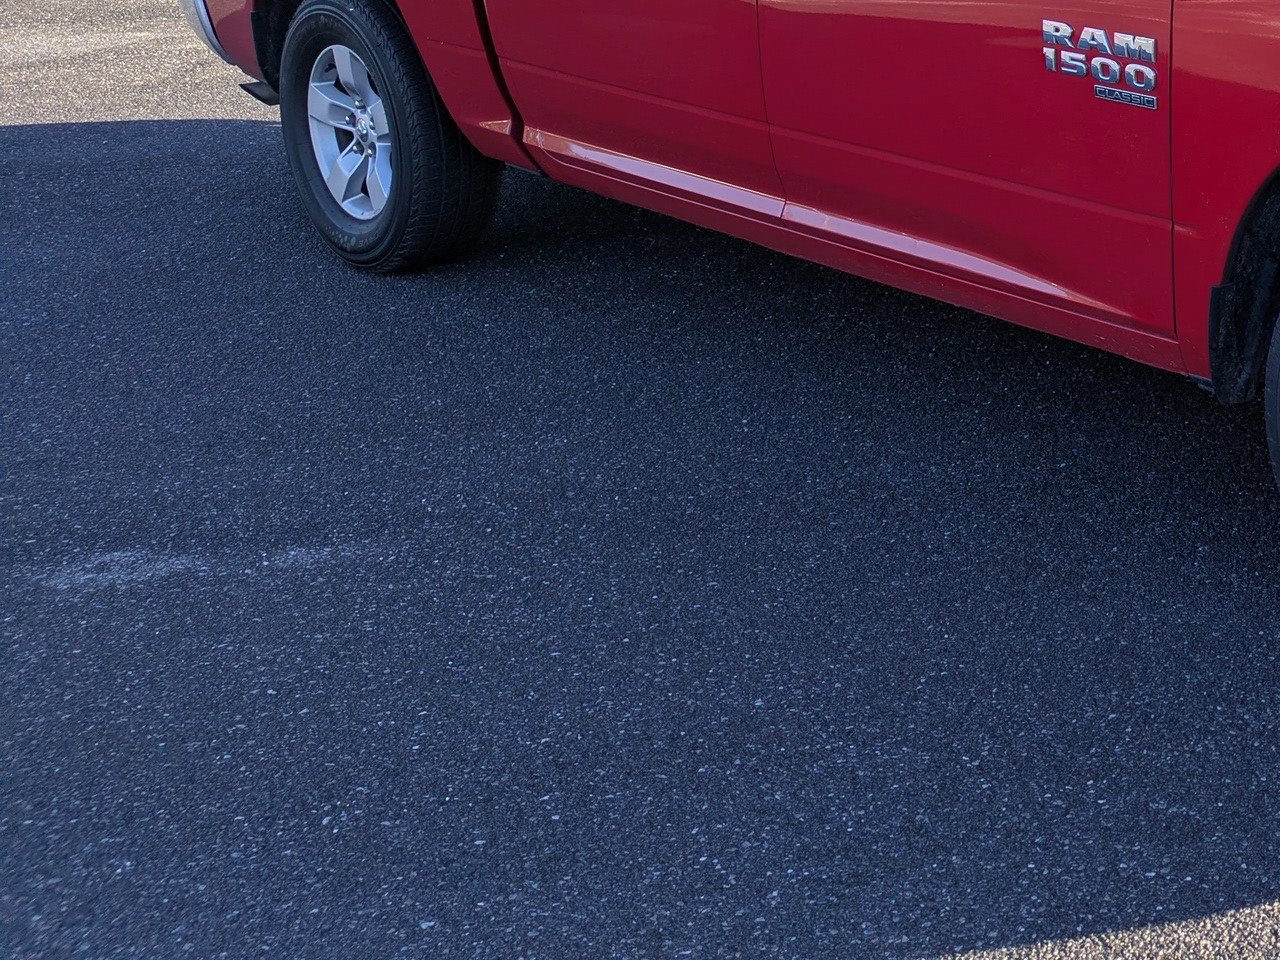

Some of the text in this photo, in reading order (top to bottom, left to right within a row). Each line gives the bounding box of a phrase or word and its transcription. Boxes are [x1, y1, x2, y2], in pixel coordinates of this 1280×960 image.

[1042, 19, 1157, 63] RAM
[1042, 46, 1158, 92] 1500
[1095, 86, 1156, 108] CLASSIC
